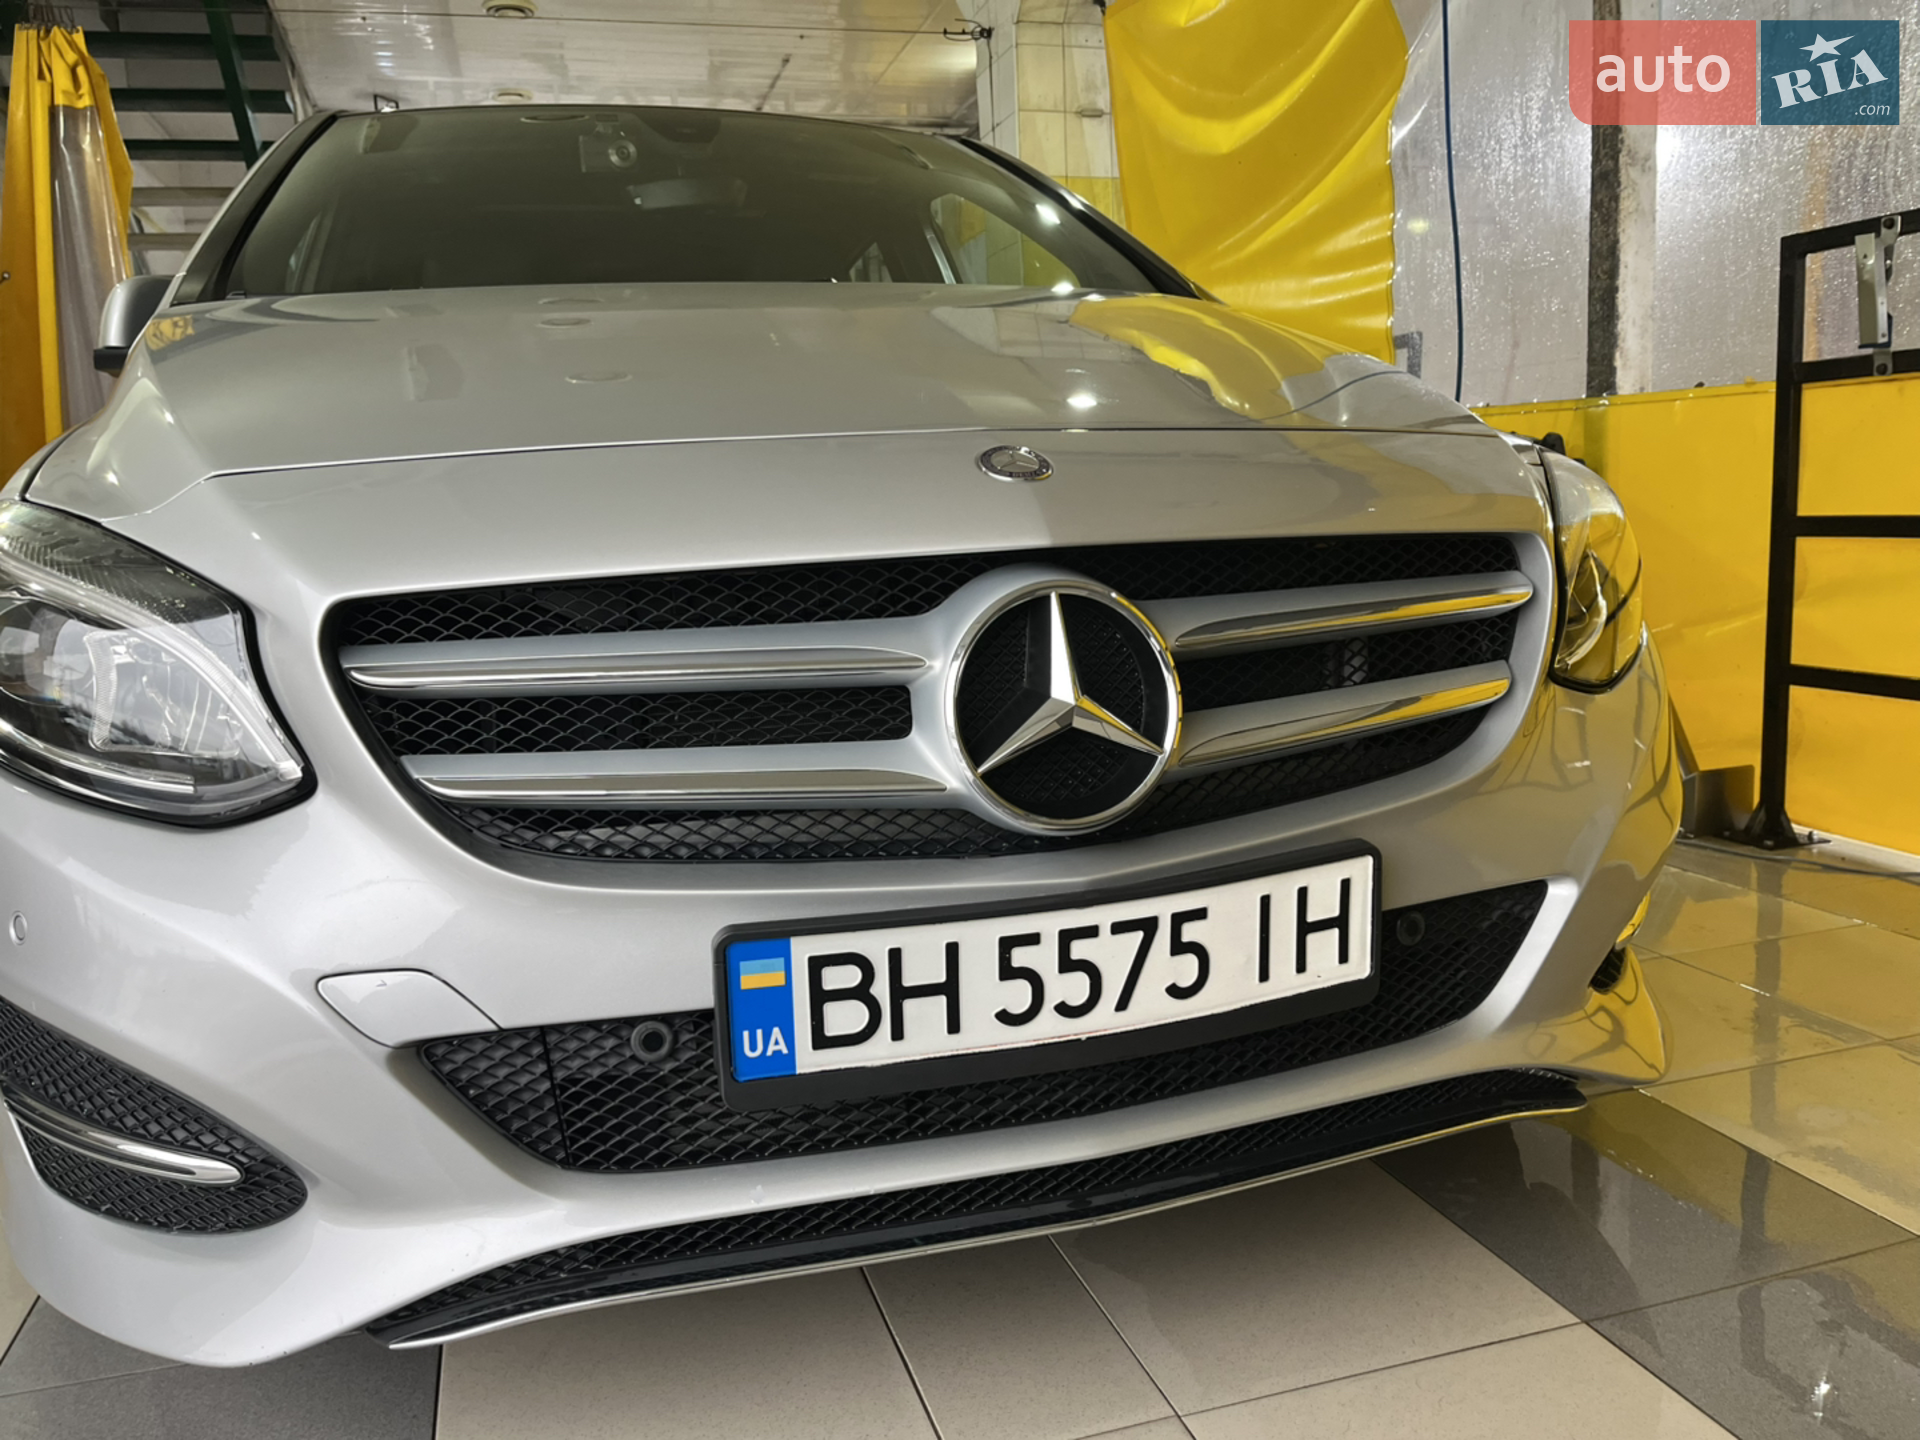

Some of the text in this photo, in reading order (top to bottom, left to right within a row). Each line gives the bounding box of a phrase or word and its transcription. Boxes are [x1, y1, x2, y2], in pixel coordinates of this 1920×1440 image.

[808, 879, 1351, 1050] BH 5575 IH
[743, 1028, 788, 1058] UA
